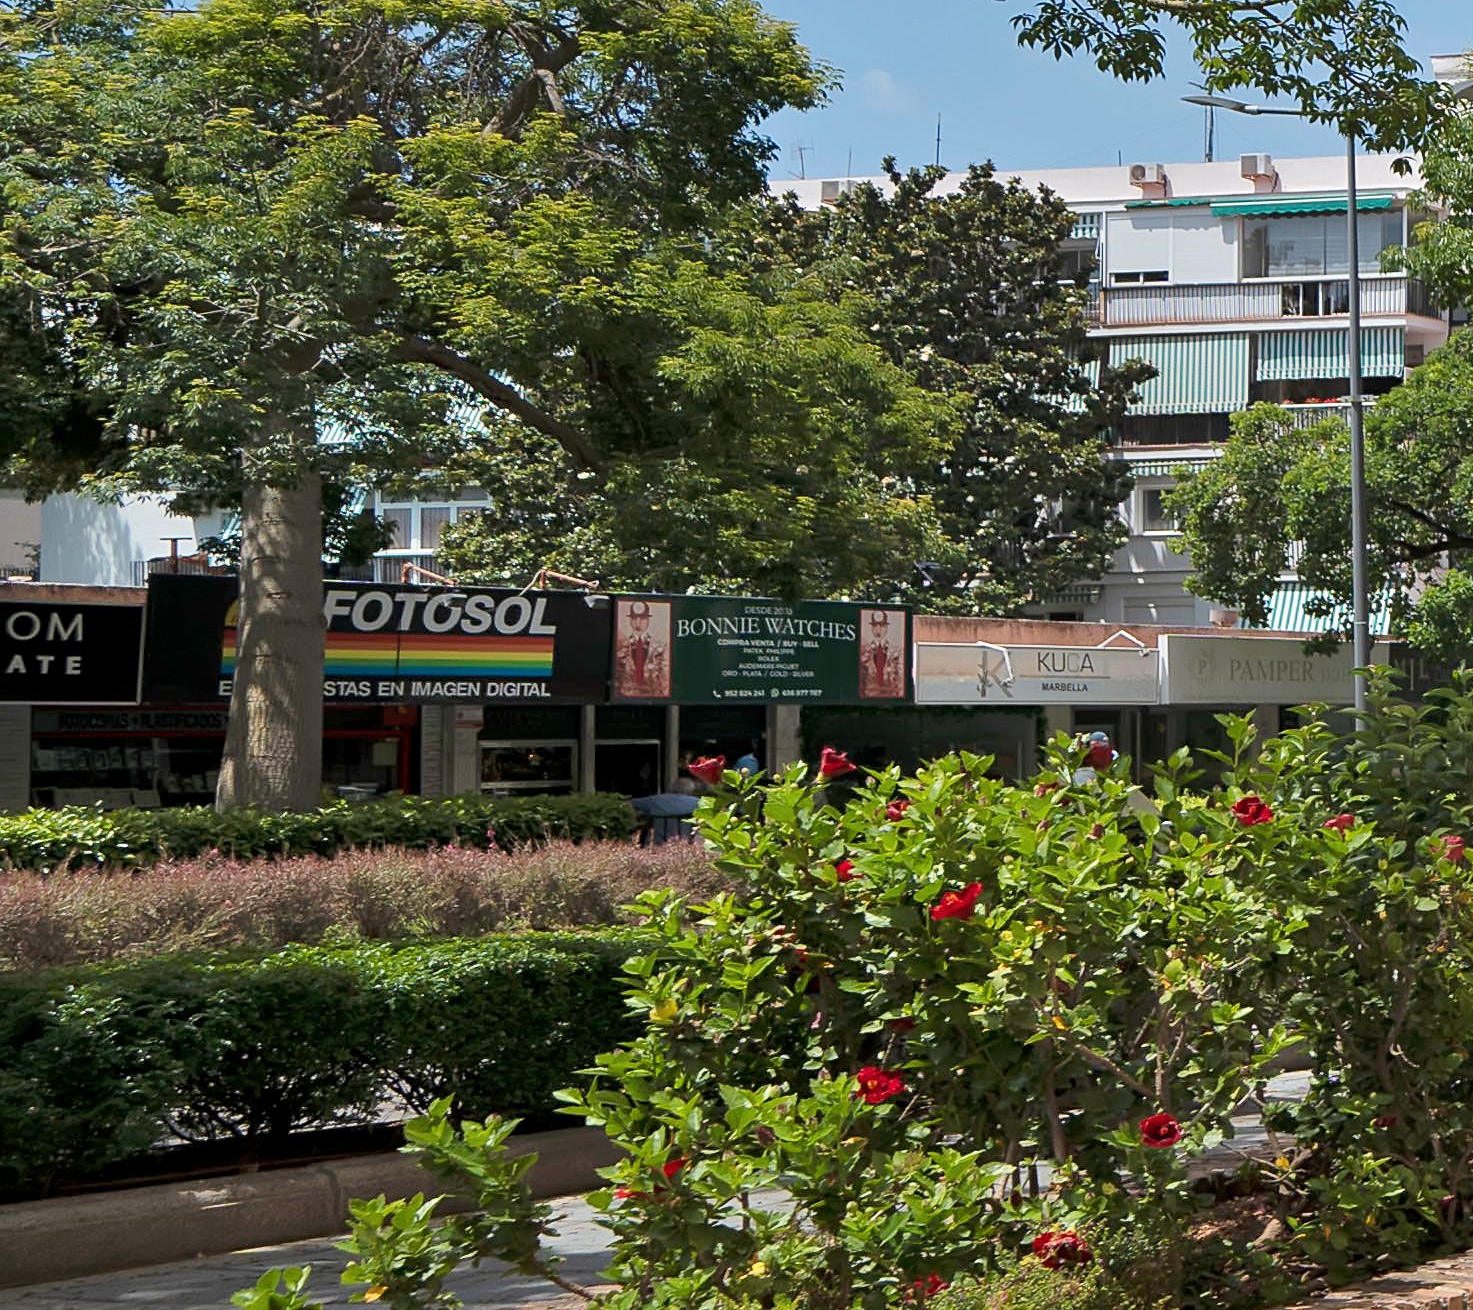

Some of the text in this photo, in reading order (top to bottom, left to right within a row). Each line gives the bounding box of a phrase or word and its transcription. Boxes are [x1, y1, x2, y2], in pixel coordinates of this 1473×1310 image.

[323, 591, 557, 635] FOTOSOL
[677, 617, 857, 641] BONNIE WATCHES
[6, 654, 83, 675] ATE
[1037, 651, 1094, 672] KUCA
[1229, 658, 1315, 682] PAMPER
[378, 682, 404, 697] EN
[411, 682, 482, 697] IMAGEN
[487, 682, 551, 698] DIGITAL
[1041, 682, 1088, 692] MARBELLA
